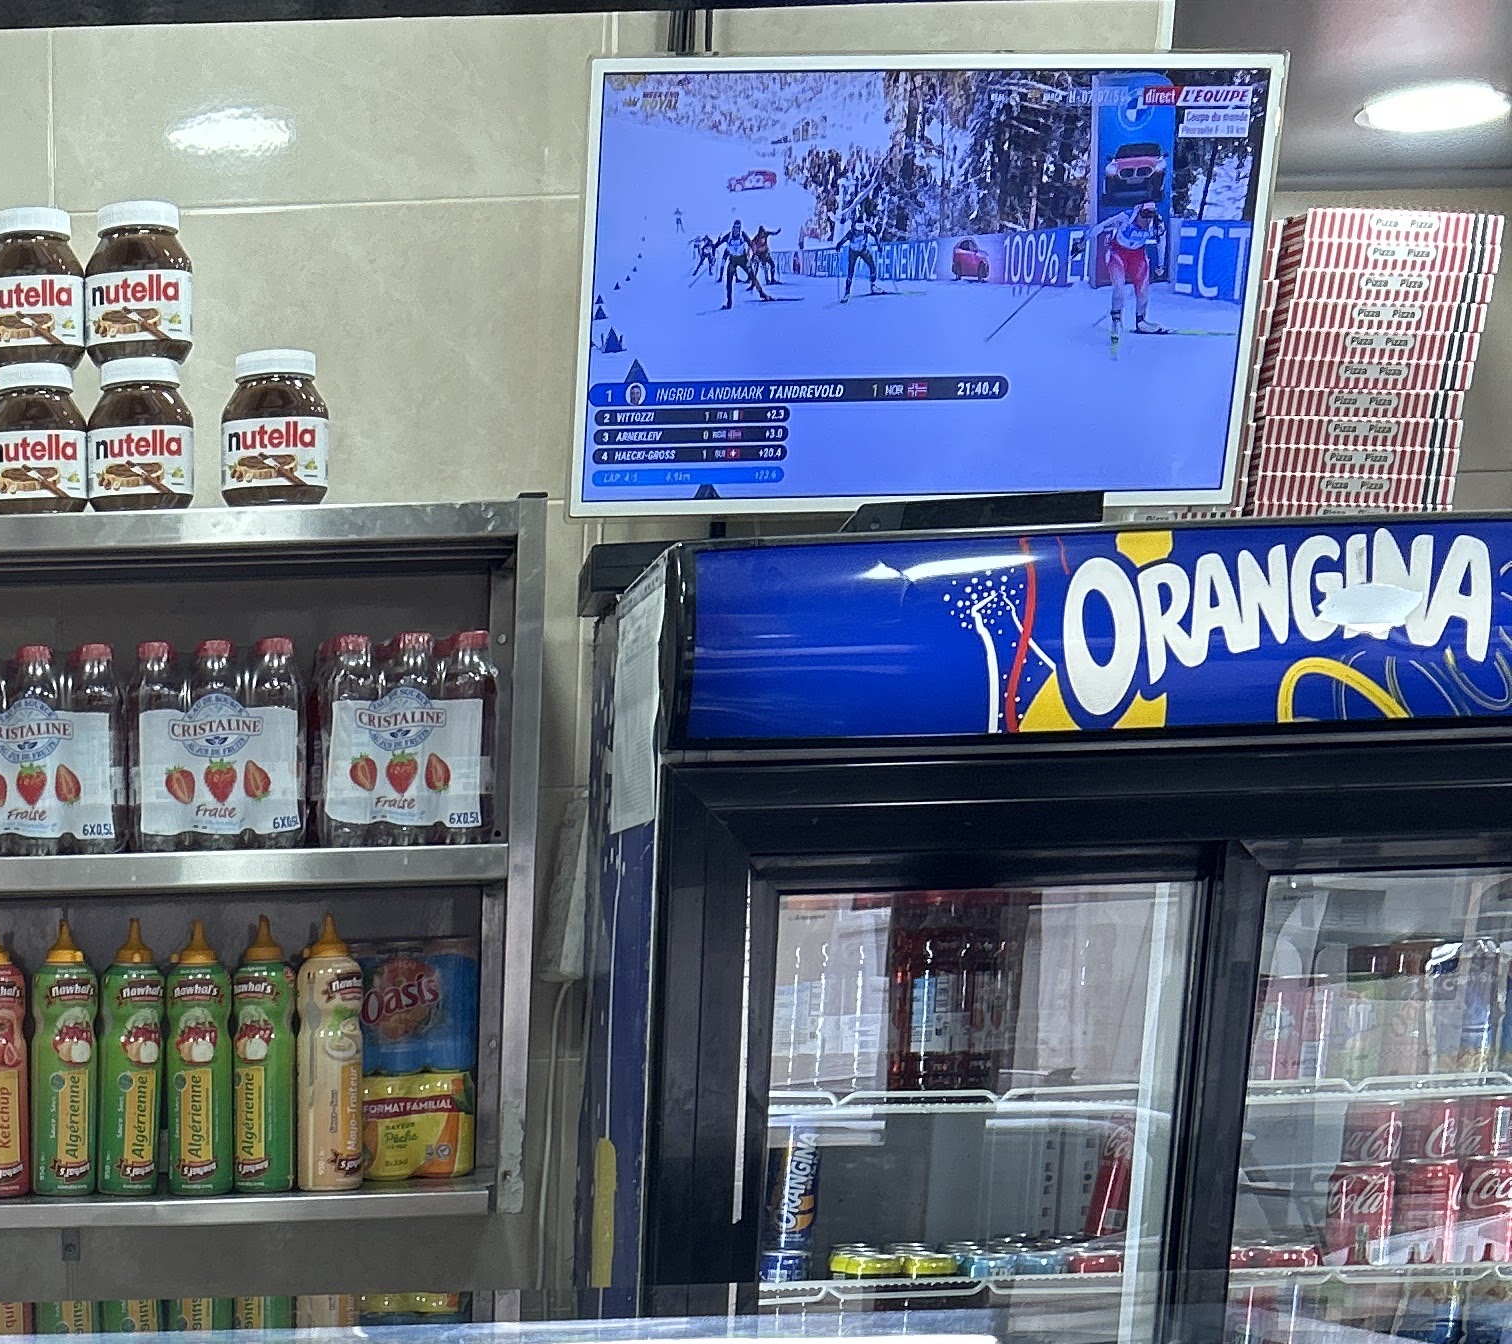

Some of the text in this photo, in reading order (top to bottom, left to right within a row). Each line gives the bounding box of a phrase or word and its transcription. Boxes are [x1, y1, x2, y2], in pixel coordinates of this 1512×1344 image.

[1145, 85, 1176, 105] direct
[1376, 218, 1433, 228] Pizza Pizza
[1003, 232, 1059, 284] 100%
[1372, 247, 1430, 258] Pizza Pizza
[91, 273, 180, 307] nutella
[1365, 277, 1424, 289] Pizza Pizza
[1357, 308, 1416, 319] Pizza Pizza
[1350, 336, 1409, 347] Pizza Pizza
[1344, 366, 1403, 377] Pizza Pizza
[605, 381, 1000, 402] 1 INGRID LANDMARK TANDREVOLD 1 NOR 21:40.4
[1334, 396, 1392, 407] Pizza Pizza
[603, 413, 610, 423] 2
[615, 411, 655, 423] VITTOZZI
[716, 411, 728, 420] ITA
[766, 409, 785, 419] +2.3
[227, 420, 316, 453] nutella
[602, 432, 609, 442] 3
[1333, 424, 1392, 434] Pizza Pizza
[95, 429, 182, 460] nutella
[601, 451, 608, 461] 4
[758, 448, 782, 458] +20.4
[1330, 453, 1388, 463] Pizza Pizza
[1325, 481, 1384, 491] Pizza Pizza
[1062, 527, 1493, 716] ORANGINA
[358, 710, 445, 728] CRISTALINE
[171, 719, 262, 738] CRISTALINE
[195, 803, 236, 819] Fraise
[374, 795, 416, 810] Fraise
[6, 805, 48, 821] Fraise
[361, 972, 442, 1027] Oasis
[239, 1072, 255, 1156] Algérienne
[363, 1095, 452, 1116] FORMAT FAMILIAL
[65, 1075, 82, 1159] Algérienne
[131, 1075, 148, 1160] Algérienne
[188, 1074, 202, 1159] Algérienne
[781, 1131, 818, 1230] ORANGINA
